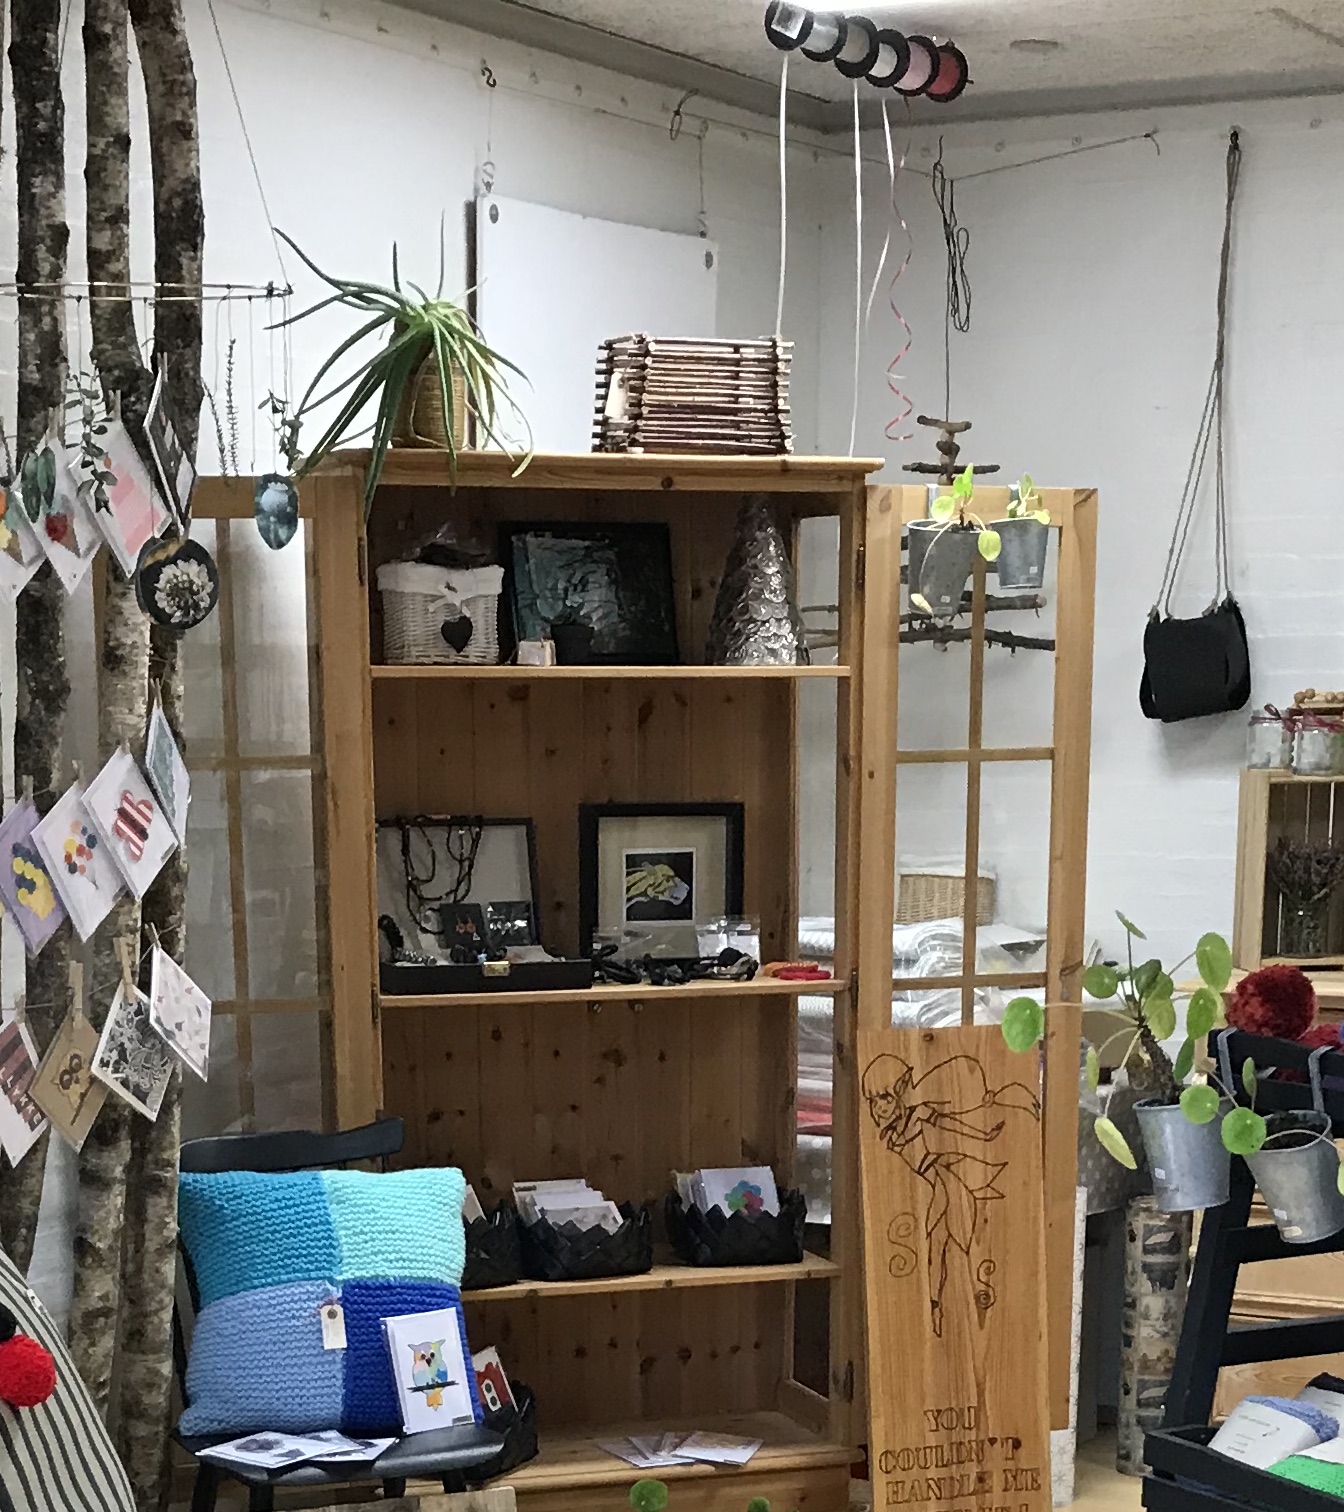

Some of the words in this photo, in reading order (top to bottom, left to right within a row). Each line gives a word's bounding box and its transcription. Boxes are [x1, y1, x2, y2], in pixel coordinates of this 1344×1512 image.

[924, 1405, 978, 1432] YOU
[885, 1471, 994, 1505] HANDLE
[1002, 1467, 1042, 1493] ME
